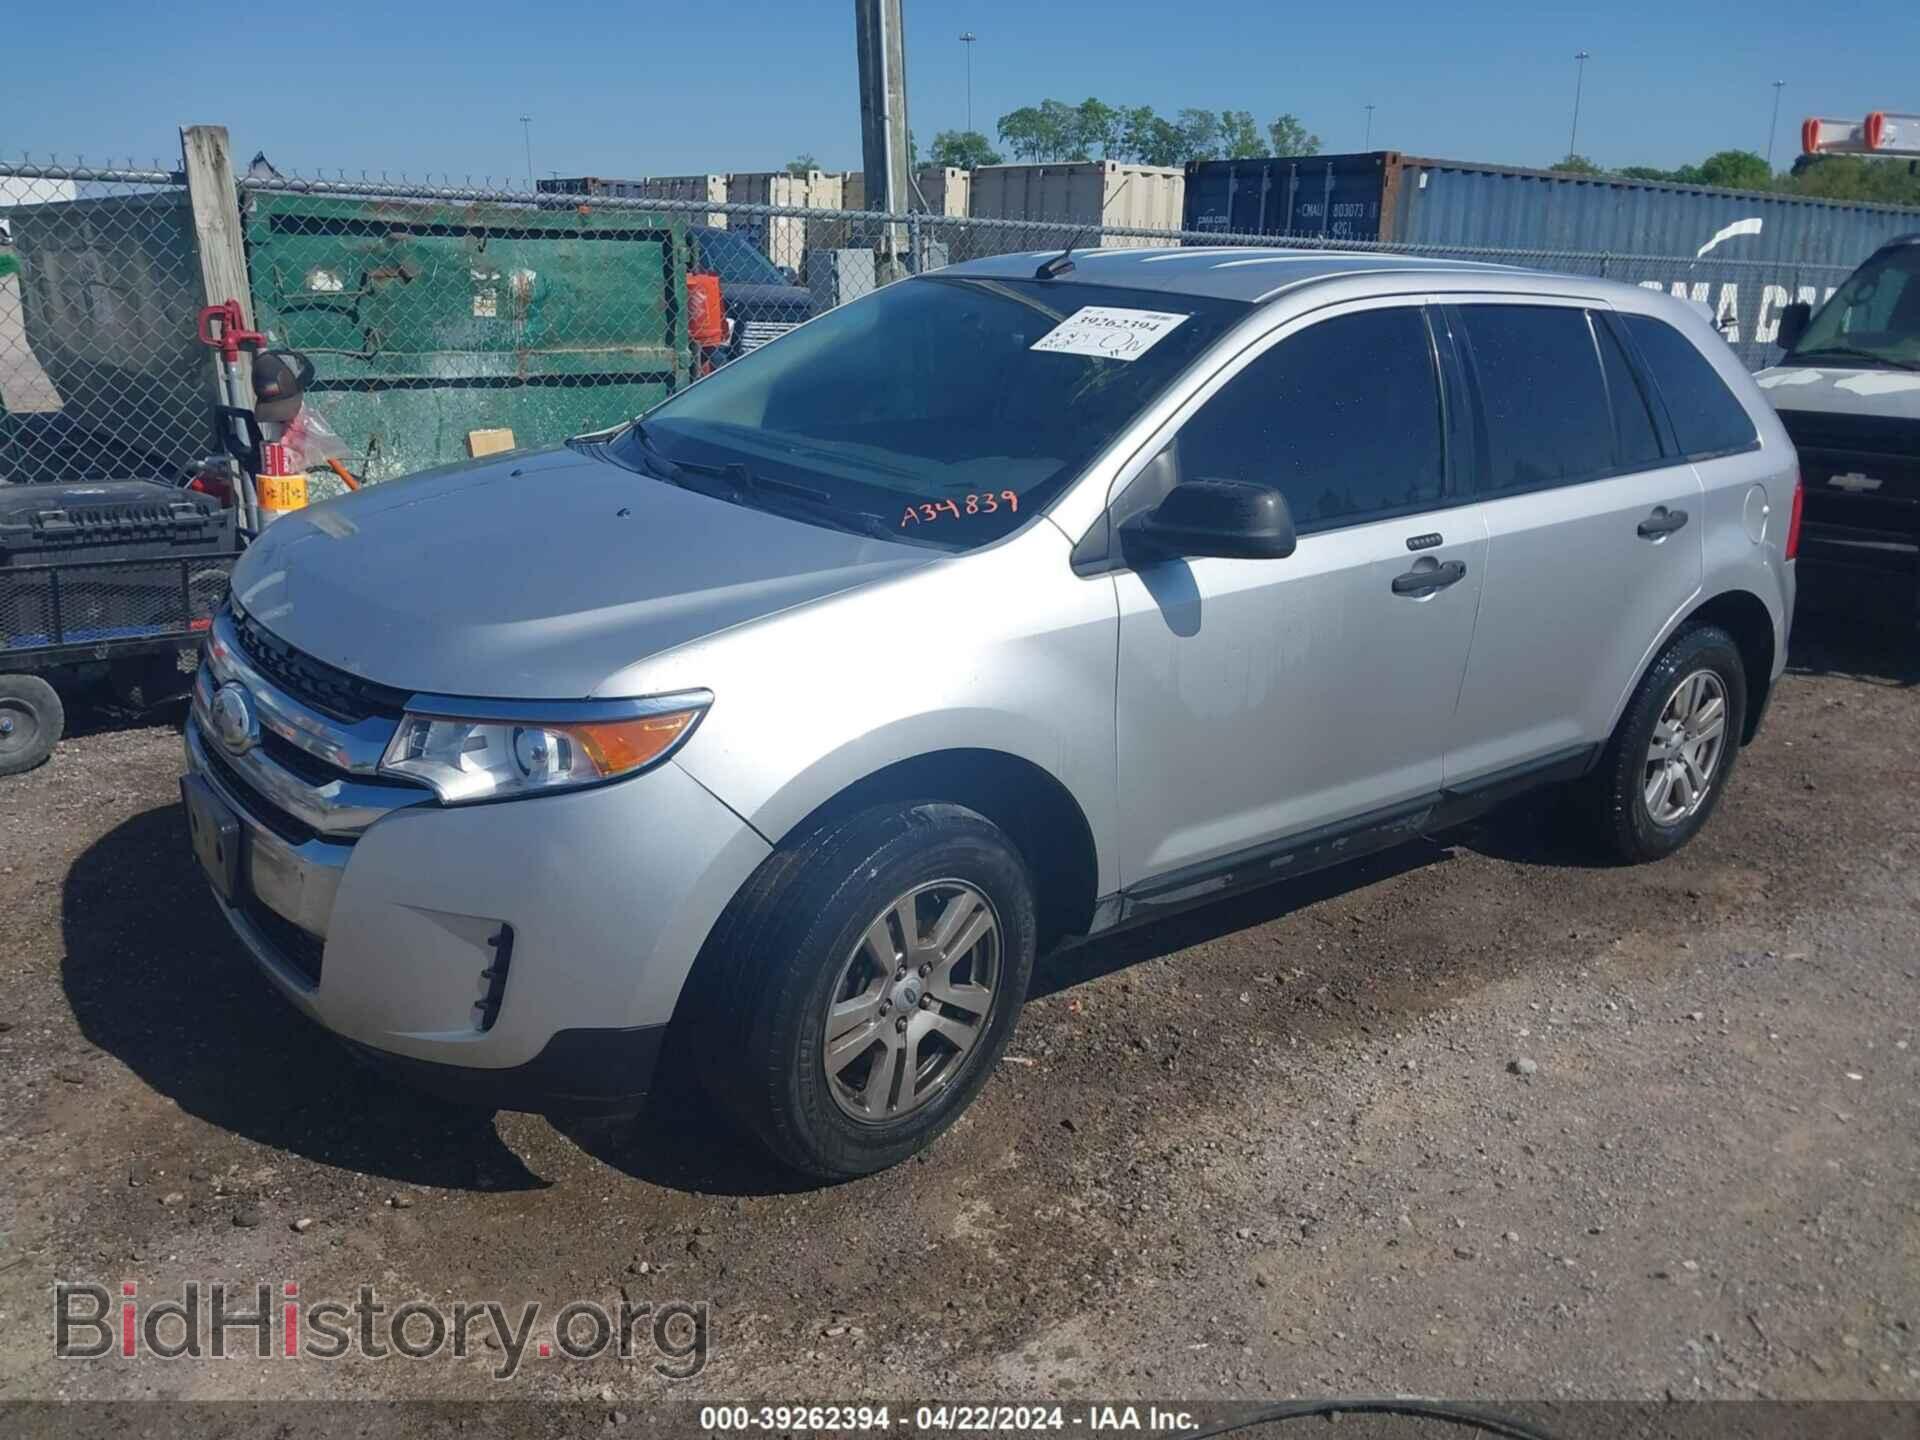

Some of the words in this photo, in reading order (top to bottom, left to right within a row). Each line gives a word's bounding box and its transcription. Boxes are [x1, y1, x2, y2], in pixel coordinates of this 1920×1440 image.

[1301, 203, 1324, 217] CMAU
[1332, 203, 1364, 217] 803073
[1075, 316, 1160, 332] 39262394
[900, 490, 1018, 528] A34839
